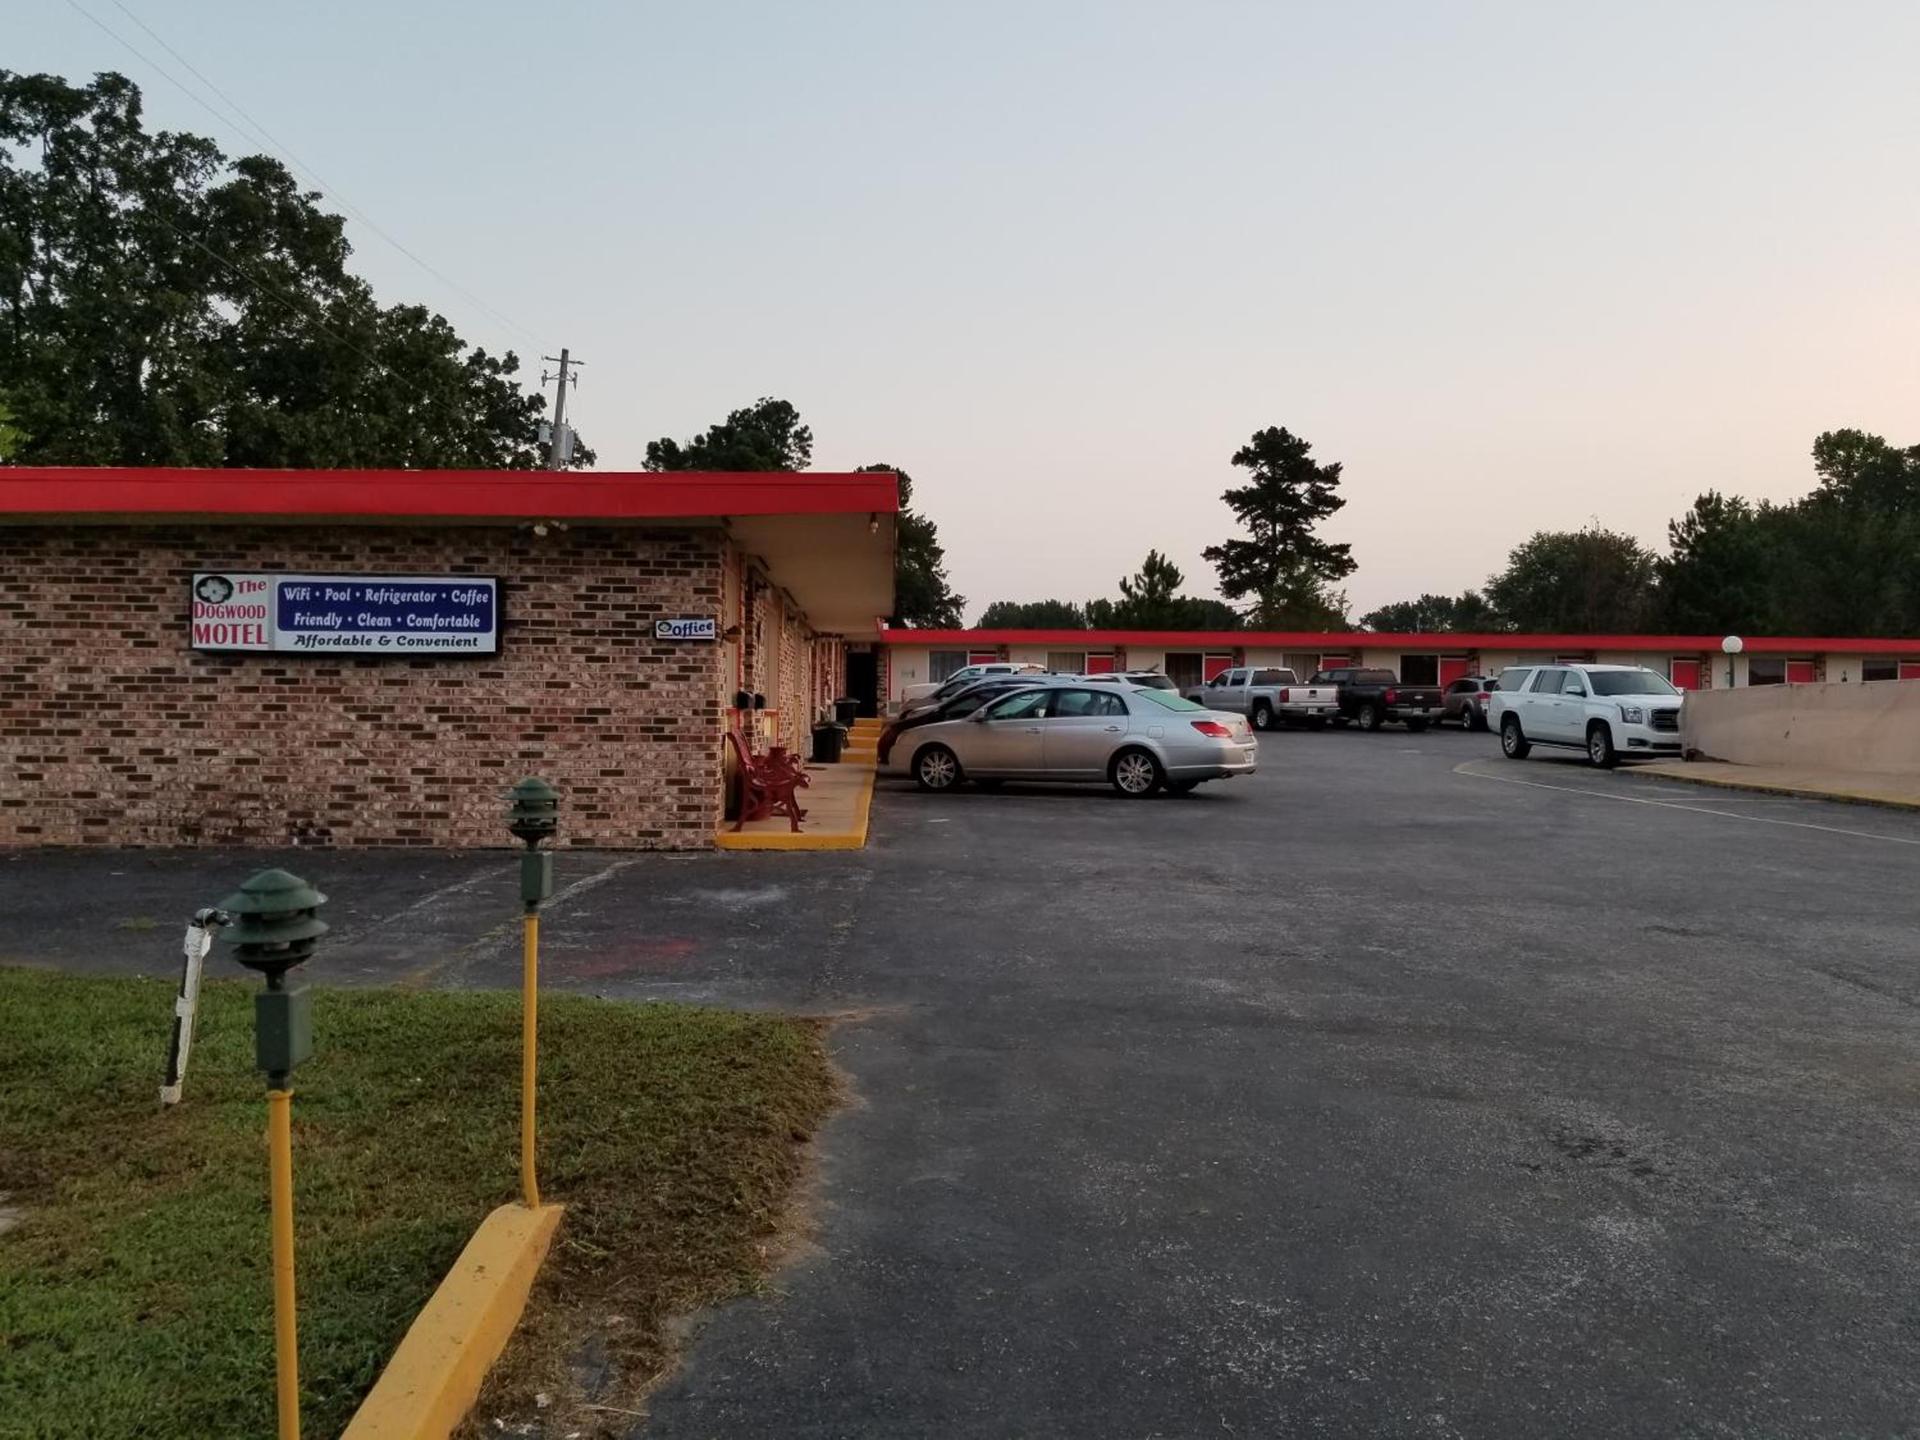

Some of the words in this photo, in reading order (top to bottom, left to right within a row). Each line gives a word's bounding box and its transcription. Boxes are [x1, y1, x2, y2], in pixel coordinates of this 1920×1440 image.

[235, 580, 267, 594] The
[284, 587, 311, 601] WiFi
[325, 588, 351, 602] Pool
[365, 588, 437, 605] Refrigerator
[451, 590, 489, 606] Coffee
[193, 601, 266, 619] DOGWOOD
[294, 612, 342, 629] Friendly
[357, 613, 392, 627] Clean
[407, 614, 480, 630] Comfortable
[672, 622, 713, 638] Office
[194, 623, 268, 645] MOTEL
[294, 634, 372, 649] Affordable
[378, 635, 392, 647] &
[396, 635, 478, 648] Convenient
